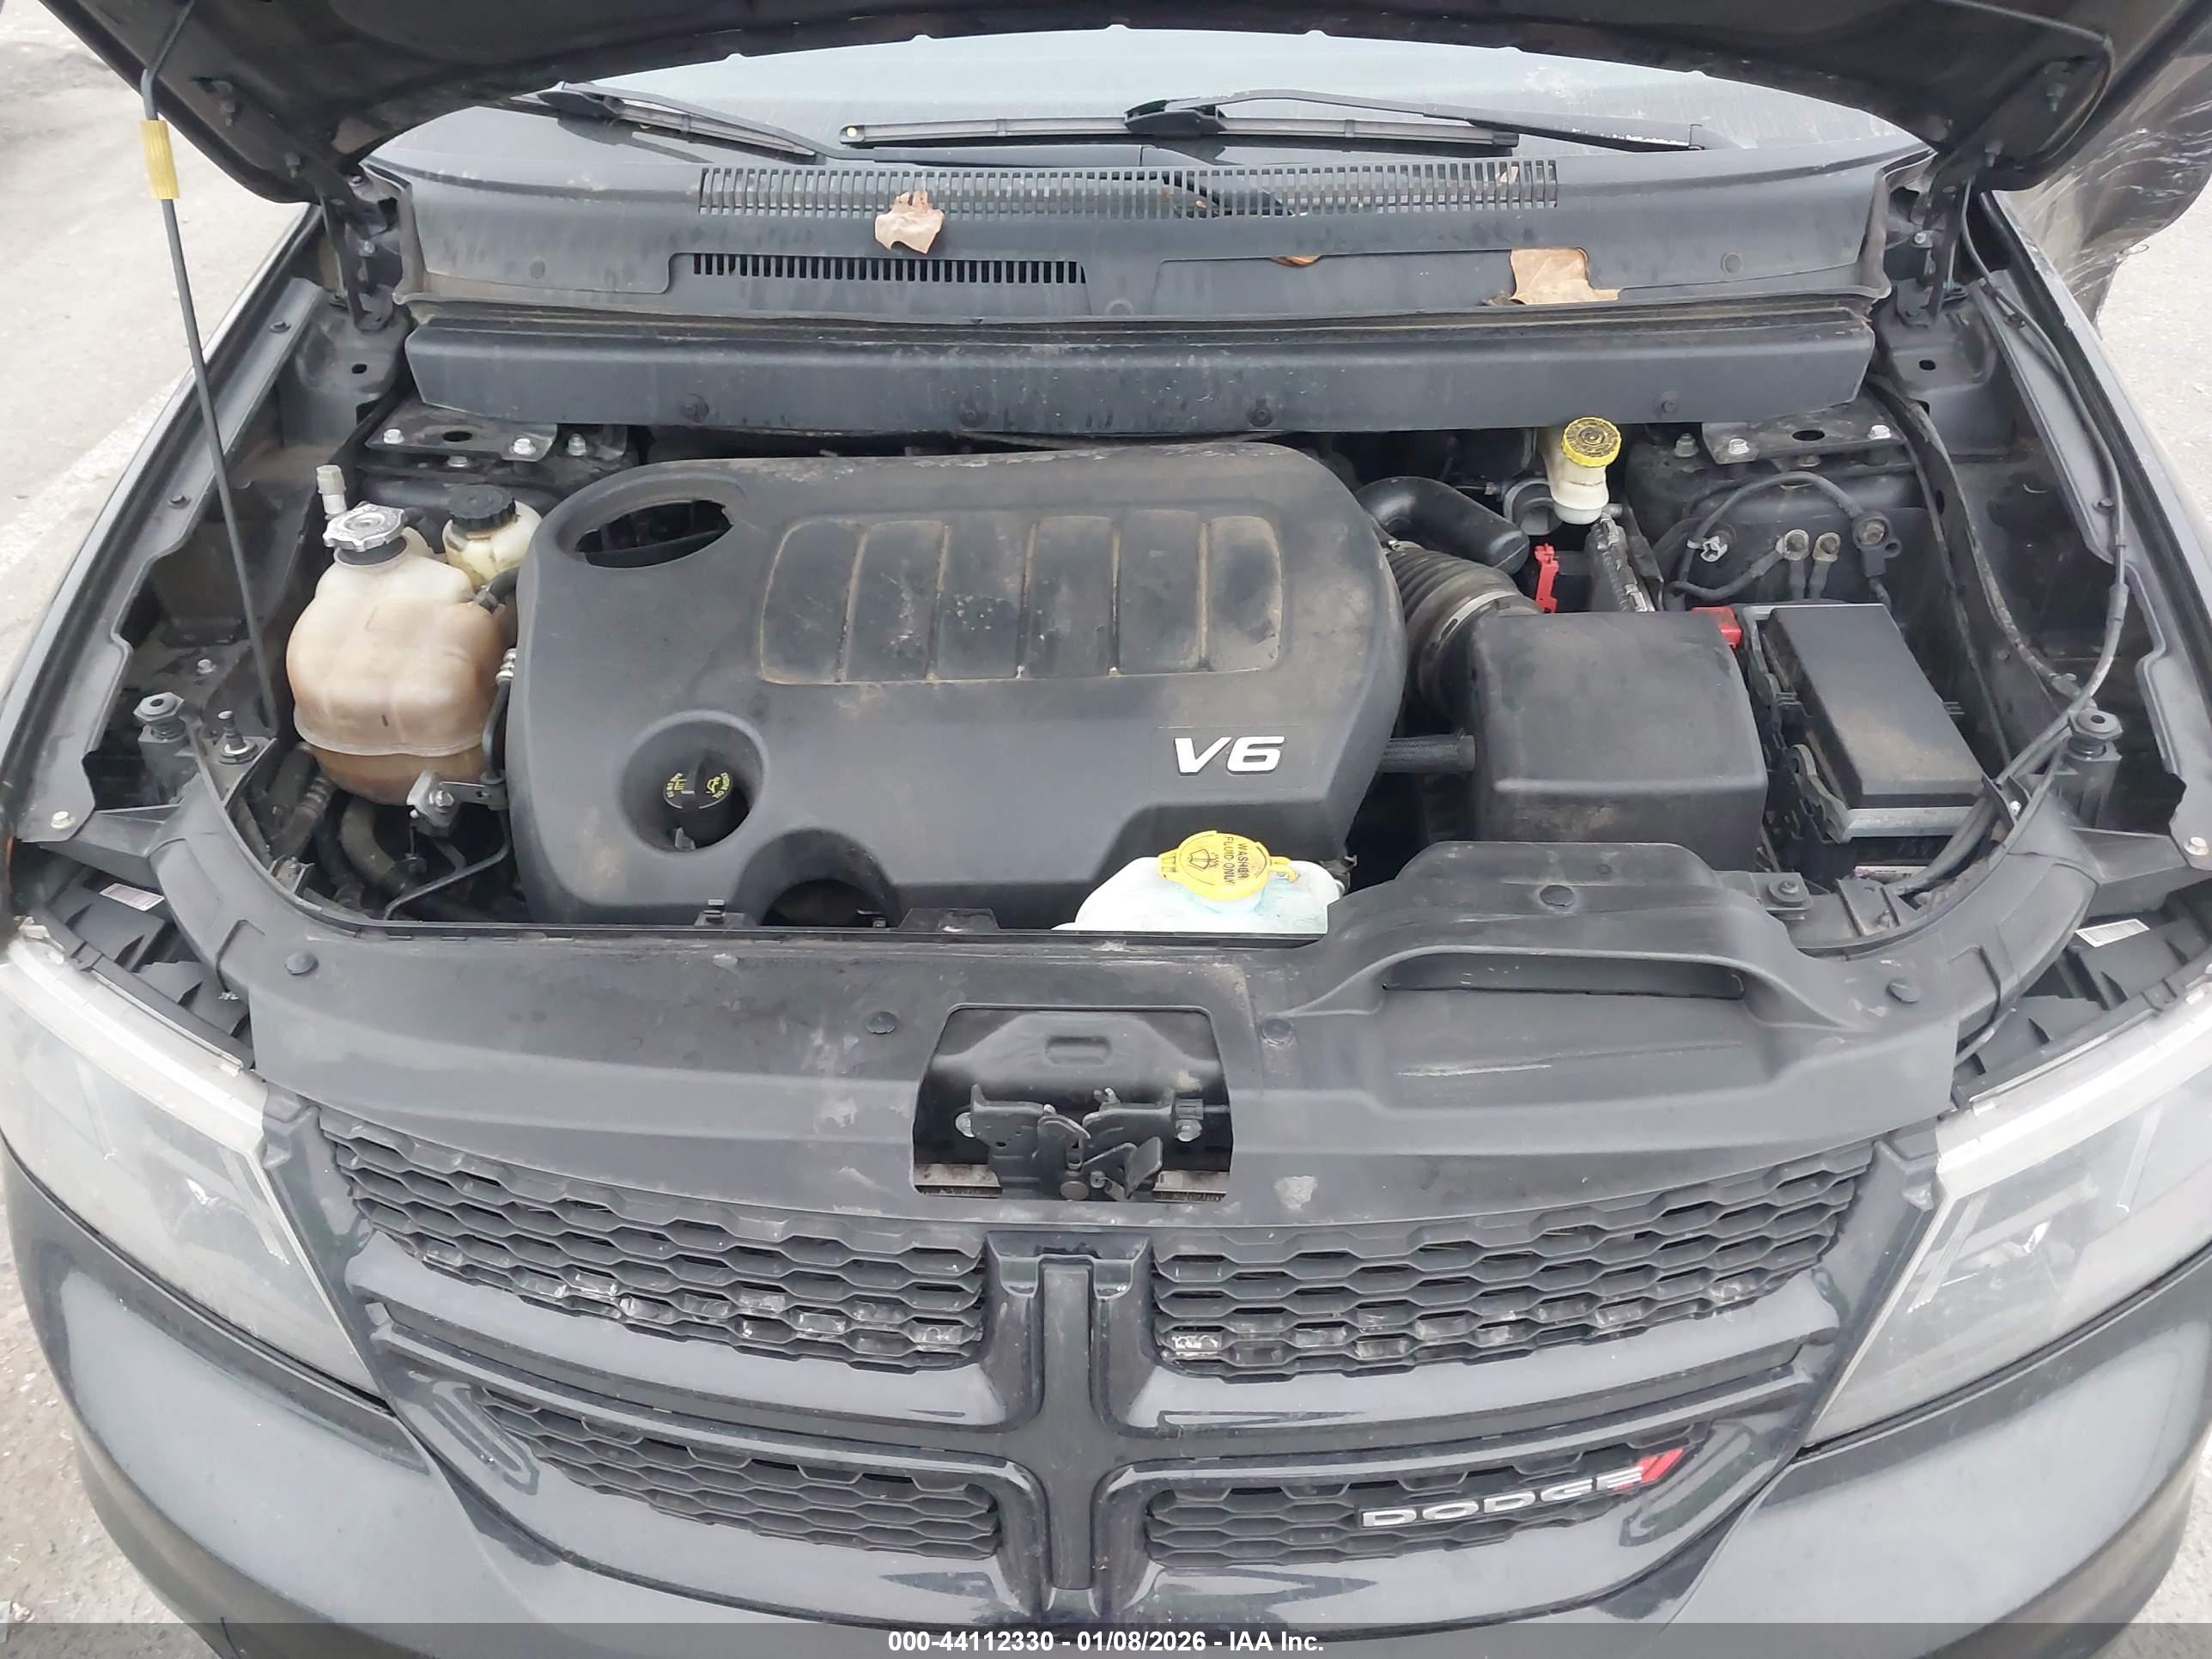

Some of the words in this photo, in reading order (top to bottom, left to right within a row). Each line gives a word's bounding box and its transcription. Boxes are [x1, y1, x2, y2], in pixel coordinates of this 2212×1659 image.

[1174, 736, 1285, 775] V6
[1223, 836, 1235, 860] FLUID
[1237, 842, 1250, 880] WASHER
[1223, 861, 1236, 885] ONLY
[1360, 1465, 1644, 1528] DODGE
